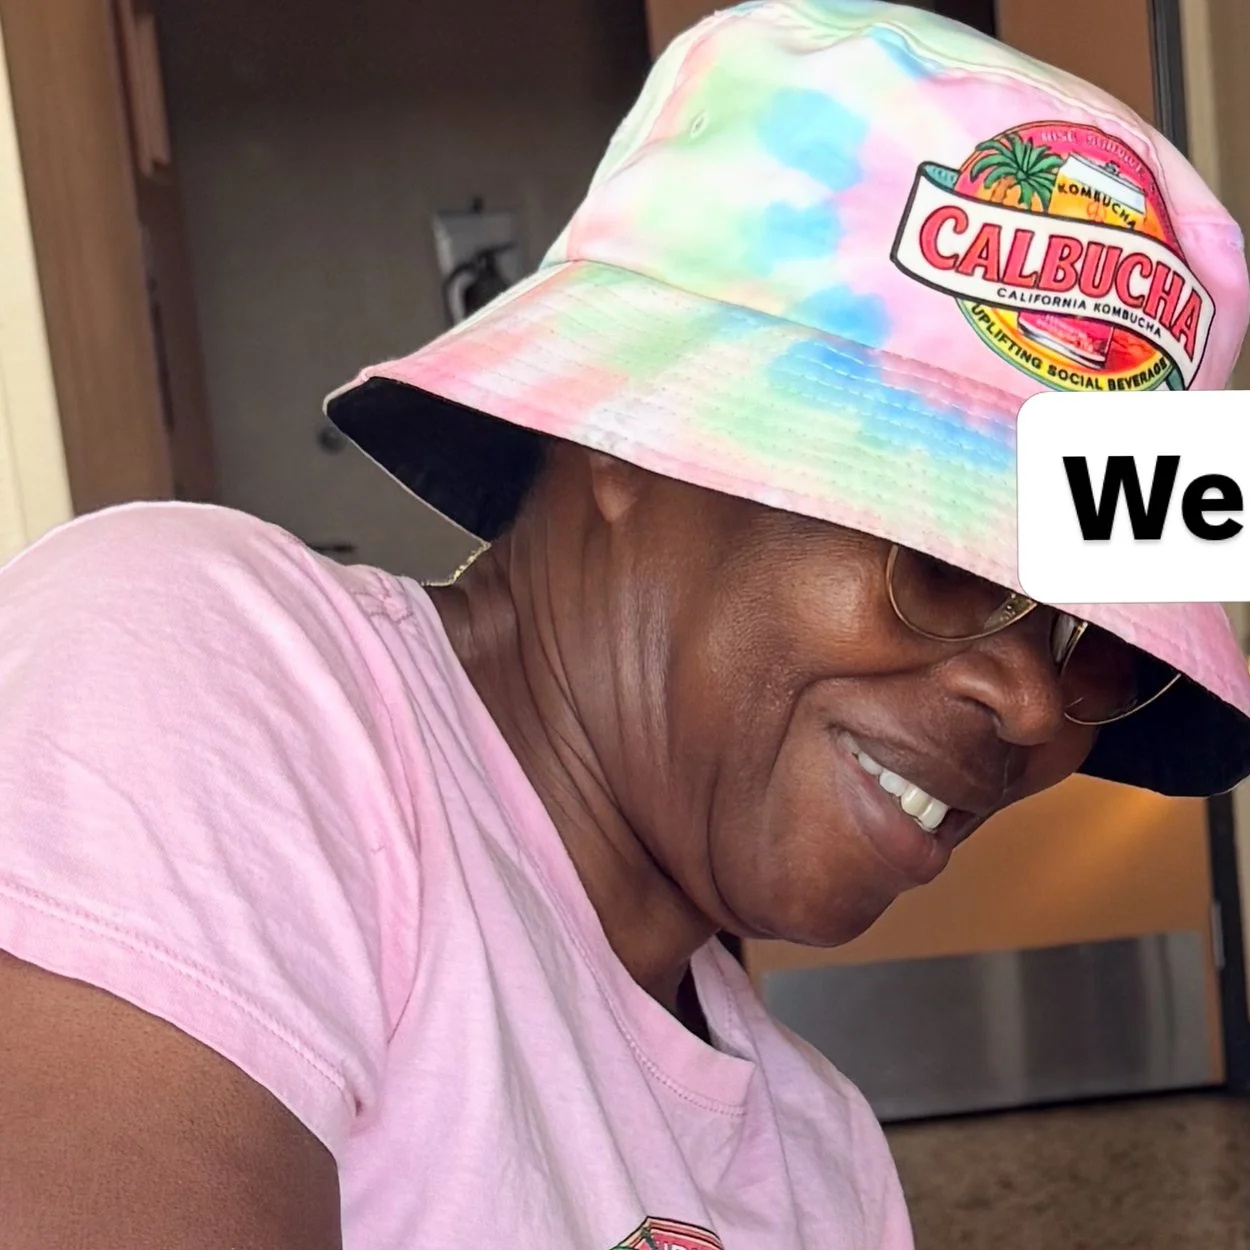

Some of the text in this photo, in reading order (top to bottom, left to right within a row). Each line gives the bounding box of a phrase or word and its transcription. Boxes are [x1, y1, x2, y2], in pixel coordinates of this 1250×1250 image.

[1057, 182, 1137, 230] KOMBUCHA
[918, 205, 1203, 363] CALBUCHA
[996, 286, 1087, 311] CALIFORNIA
[1093, 301, 1162, 338] KOMBUCHA
[971, 303, 1042, 370] UPLIFTING
[1046, 364, 1103, 391] SOCIAL
